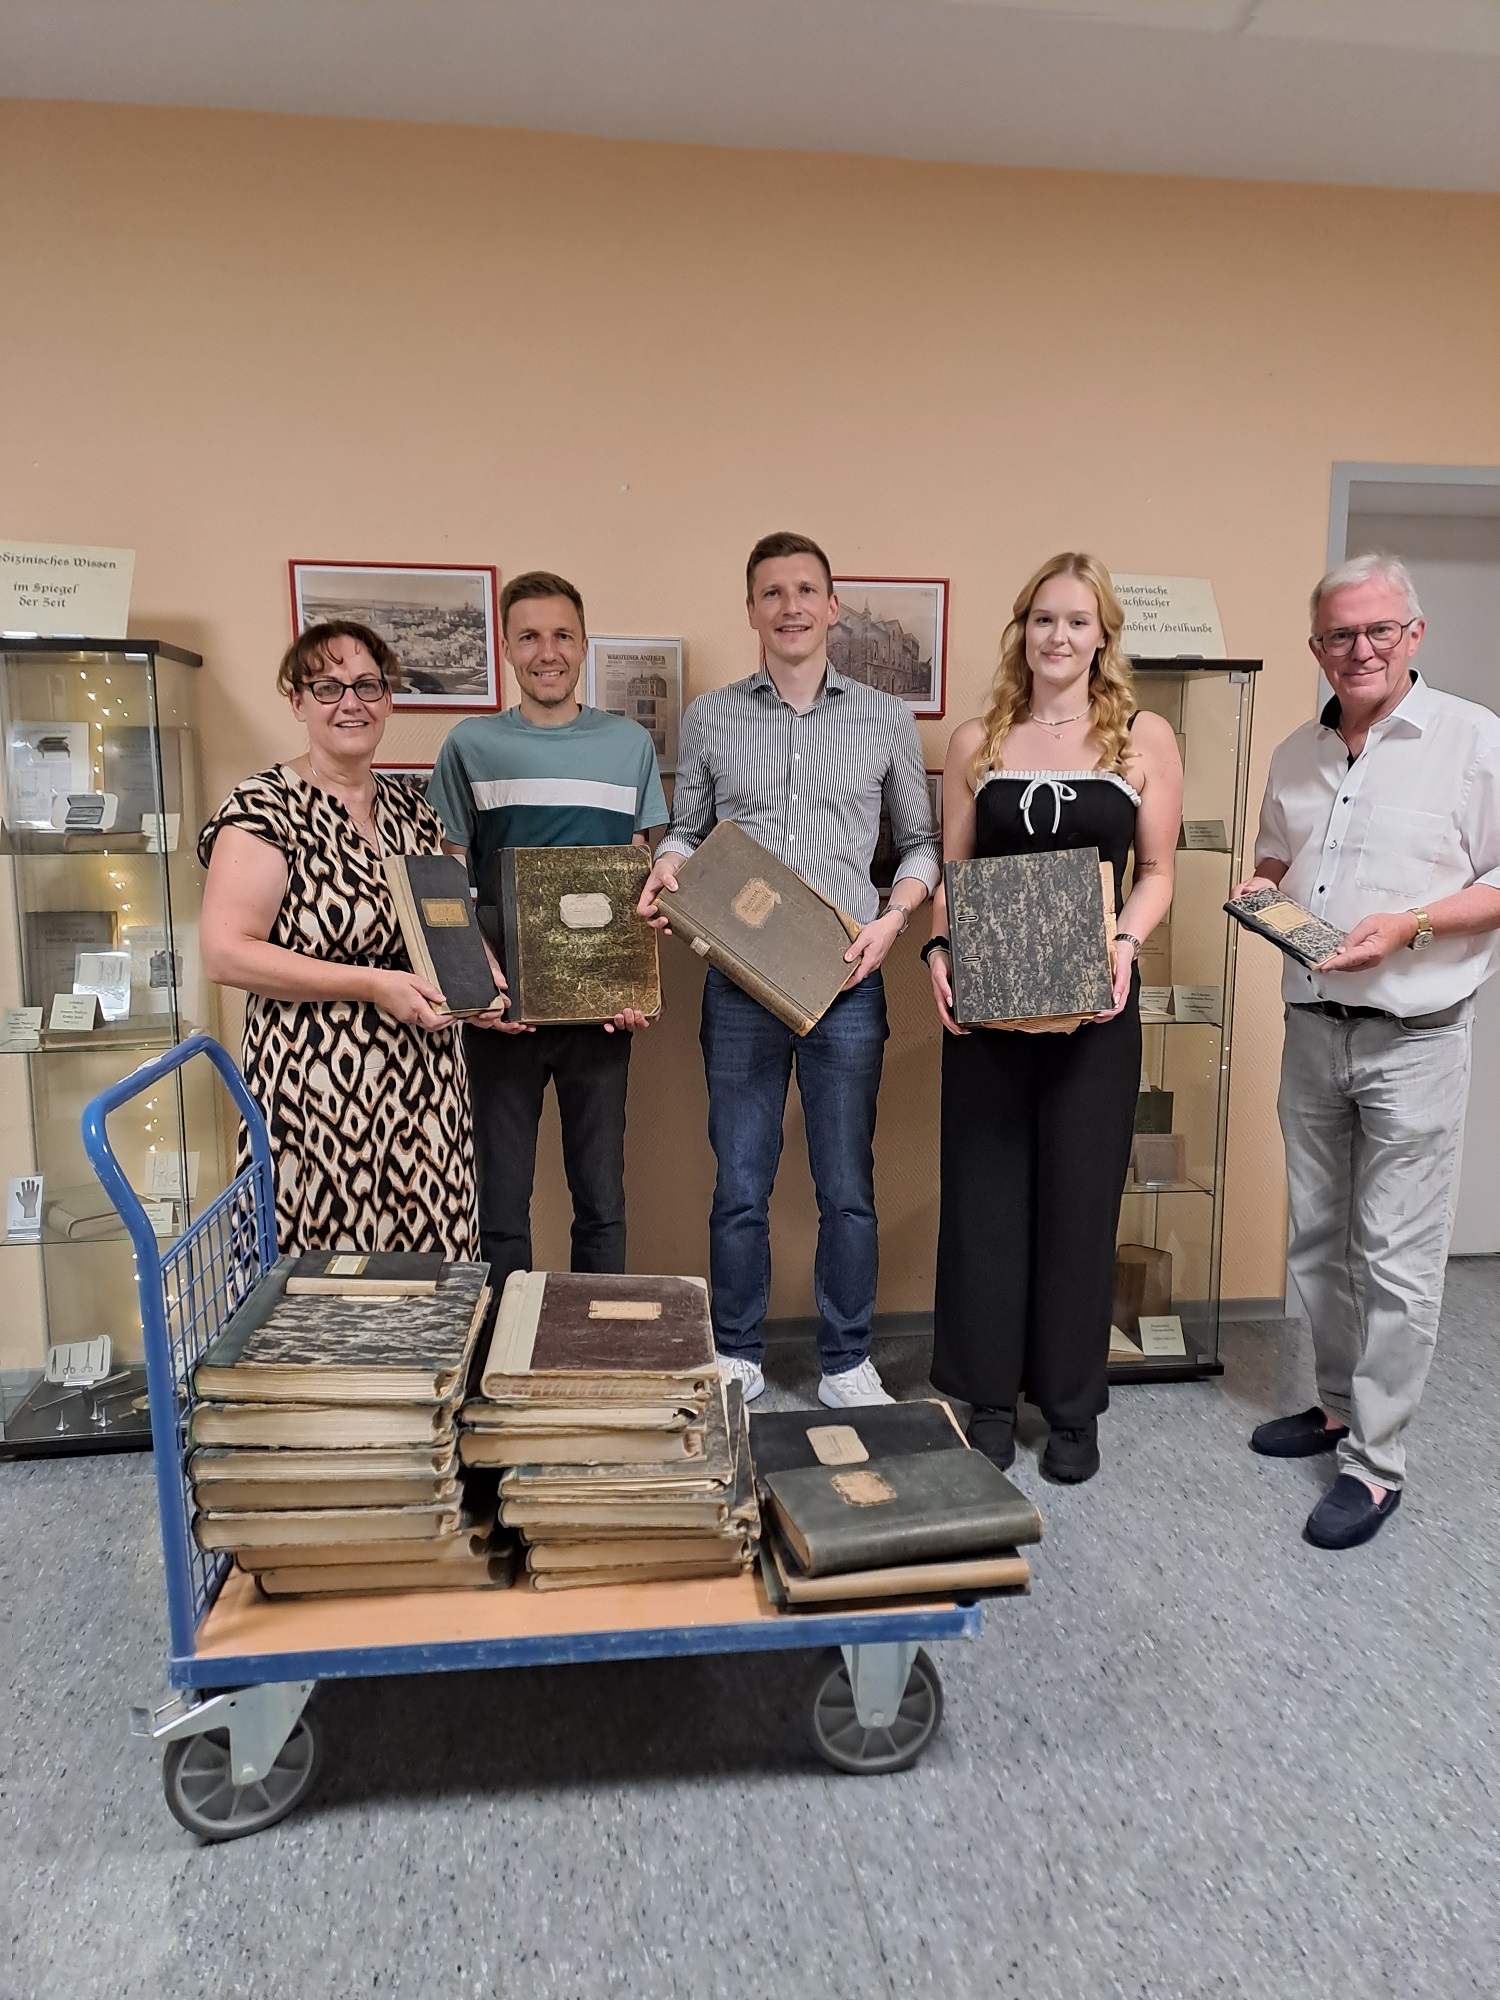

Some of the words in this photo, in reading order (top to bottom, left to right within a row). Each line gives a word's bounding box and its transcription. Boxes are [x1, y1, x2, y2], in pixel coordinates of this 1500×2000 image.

[0, 552, 70, 567] dizinisches
[73, 557, 116, 569] Wissen
[13, 581, 29, 592] im
[32, 582, 79, 596] Spiegel
[1114, 585, 1168, 595] Historische
[19, 595, 39, 607] der
[42, 597, 66, 608] Zeit
[1118, 597, 1170, 607] achbücher
[1142, 611, 1158, 620] zur
[1123, 621, 1156, 632] ndheit
